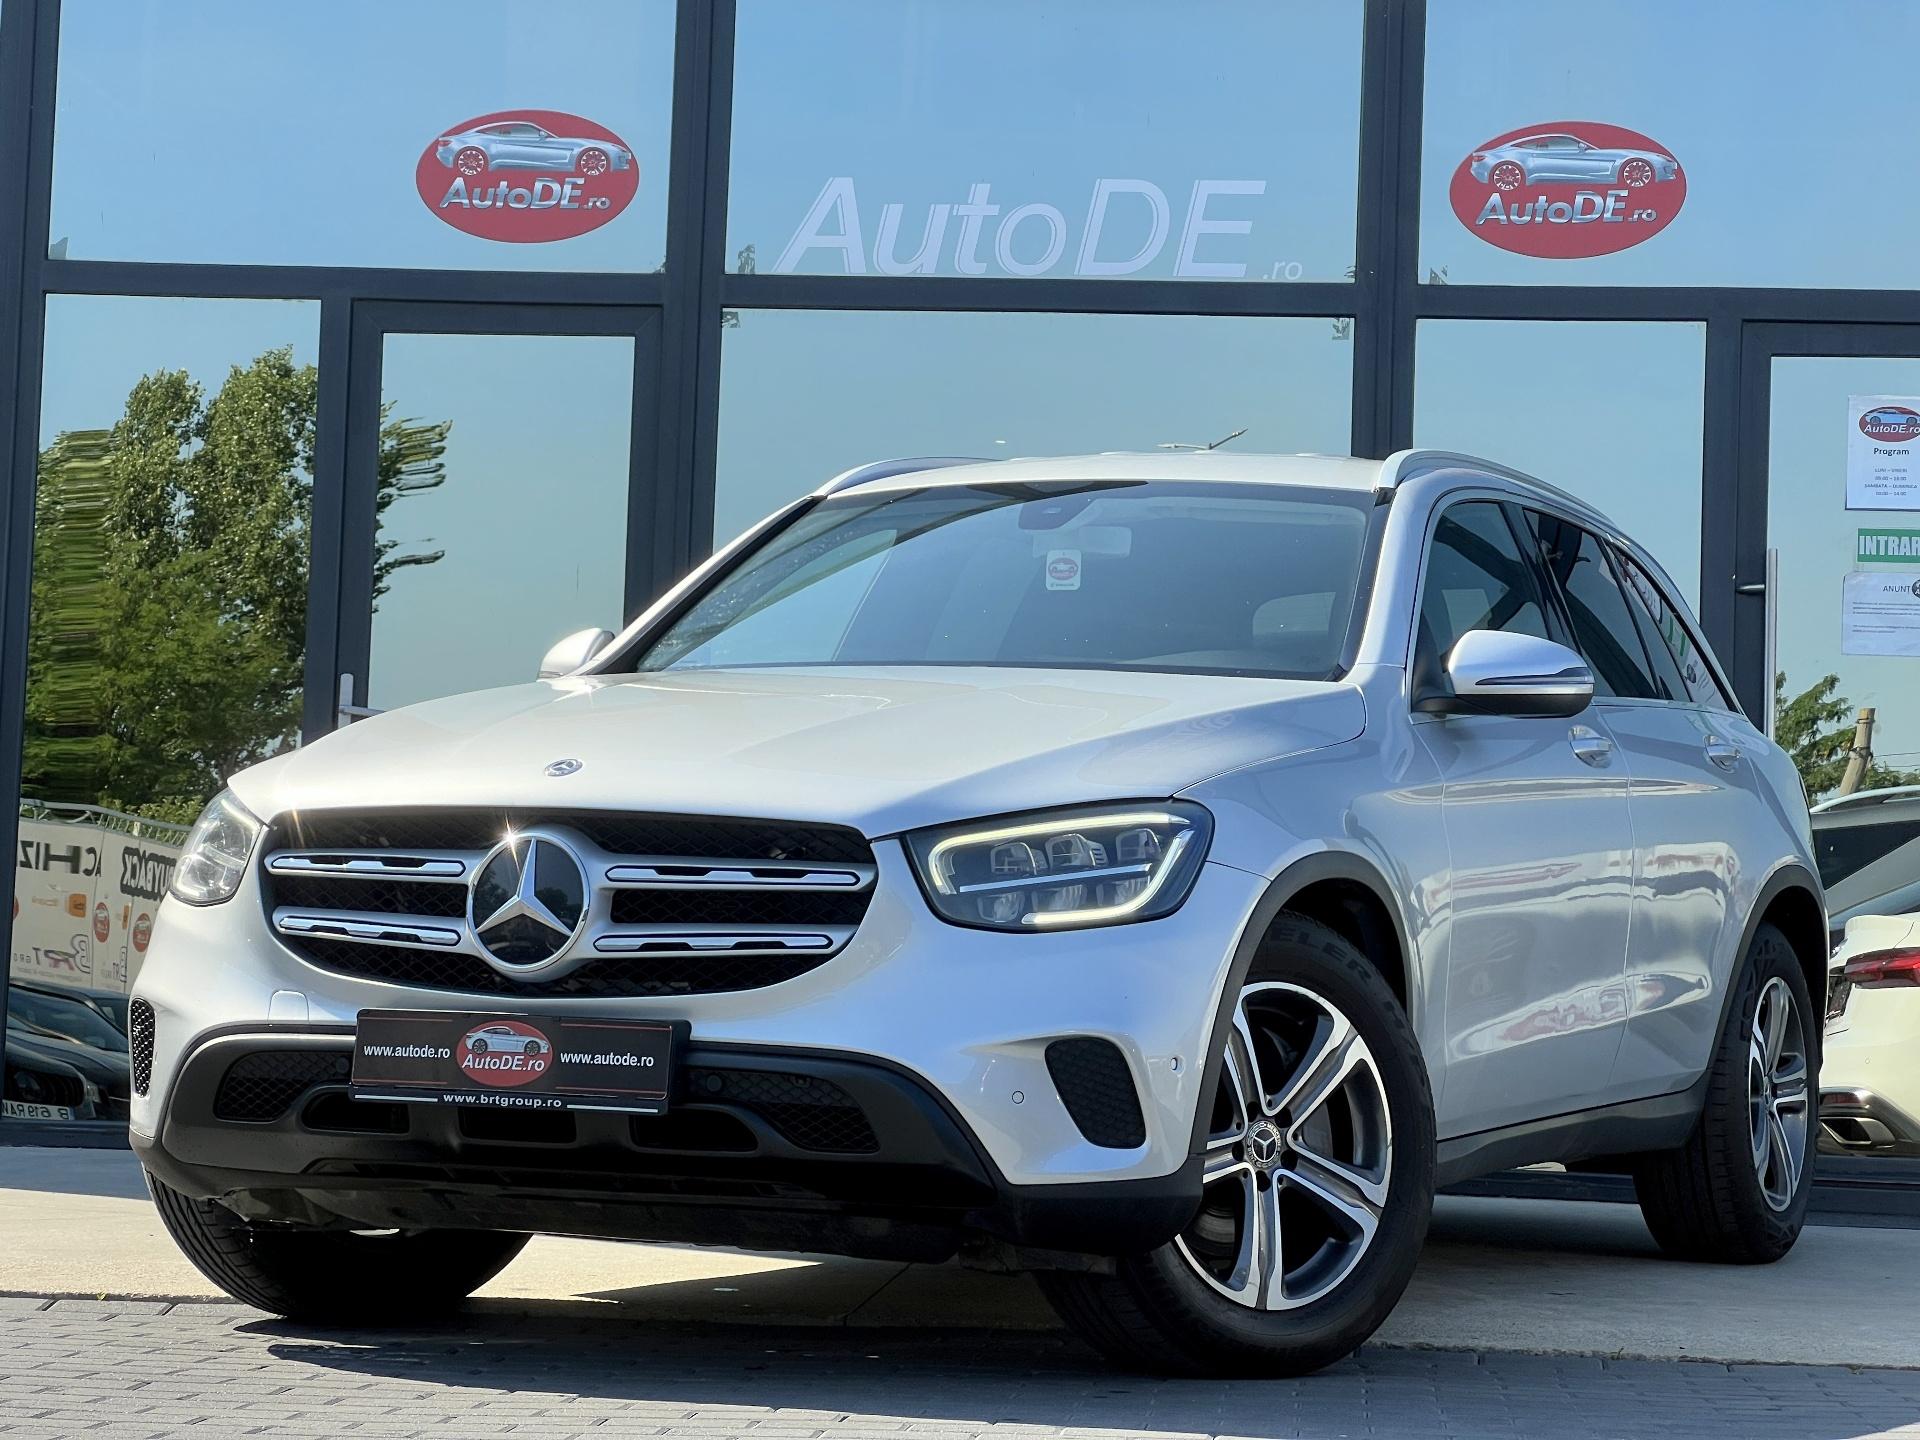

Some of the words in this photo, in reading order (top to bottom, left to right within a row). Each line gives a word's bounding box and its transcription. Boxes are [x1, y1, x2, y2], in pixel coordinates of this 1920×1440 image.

[1873, 447, 1910, 456] Program
[364, 1044, 450, 1059] www.autode.ro
[461, 1053, 545, 1071] AutoDE.ro
[560, 1053, 654, 1067] www.autode.ro
[443, 1094, 562, 1109] www.brtgroup.ro
